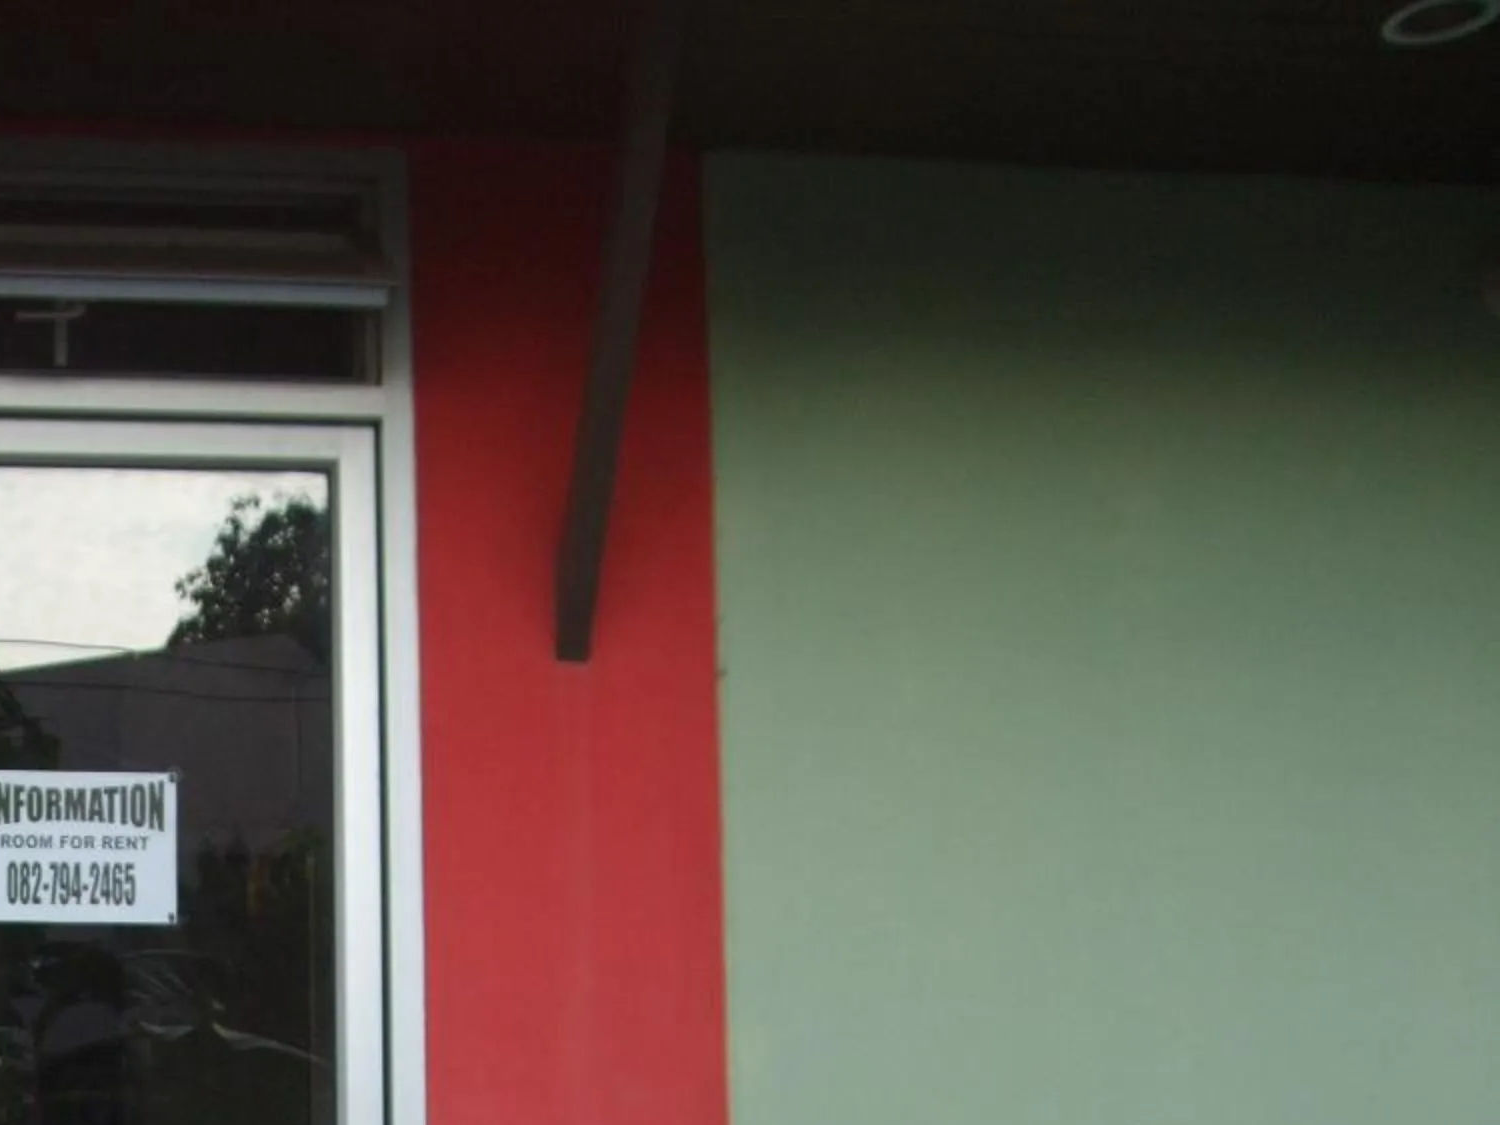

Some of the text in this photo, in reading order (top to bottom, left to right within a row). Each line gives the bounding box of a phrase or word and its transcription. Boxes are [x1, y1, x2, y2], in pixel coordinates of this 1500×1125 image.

[0, 834, 149, 850] ROOM FOR RENT
[7, 861, 136, 906] 082-794-2465
